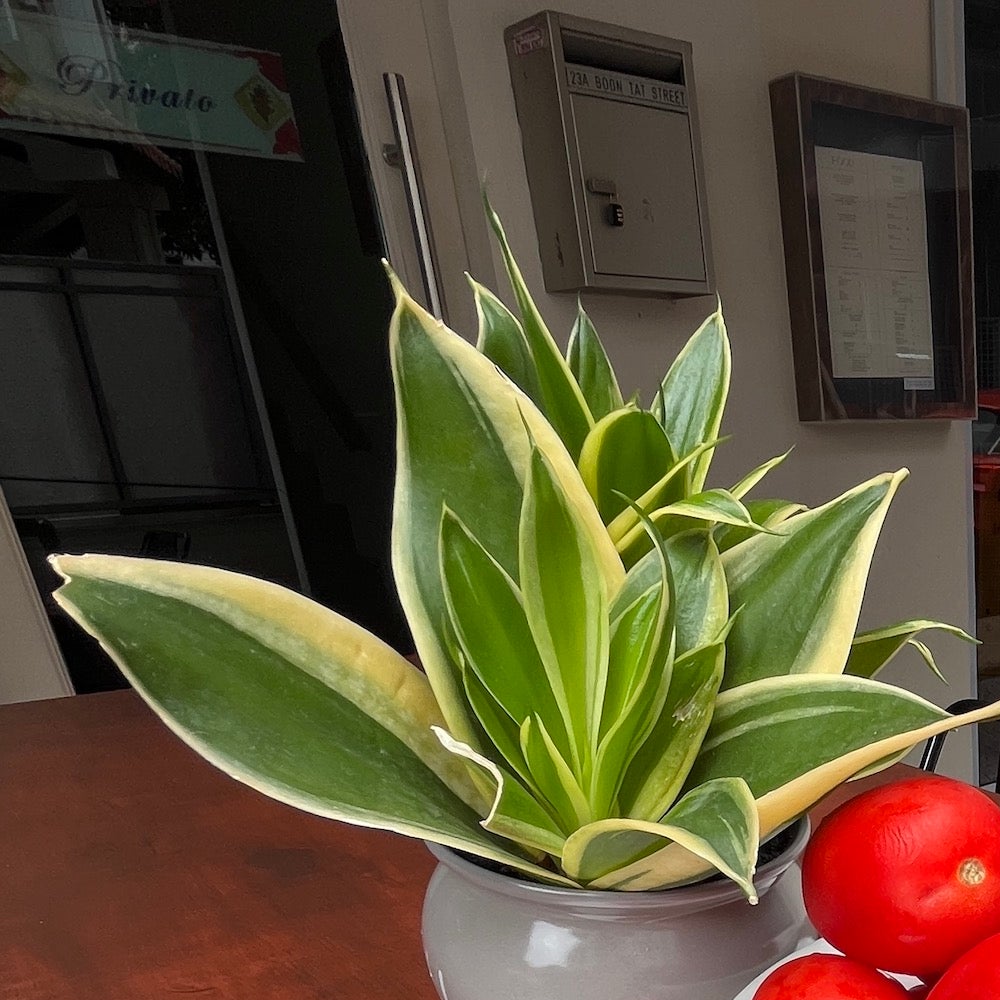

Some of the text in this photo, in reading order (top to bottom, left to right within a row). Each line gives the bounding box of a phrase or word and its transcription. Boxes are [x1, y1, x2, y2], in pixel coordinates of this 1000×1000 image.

[569, 71, 686, 105] 23A BOON TAT STREET
